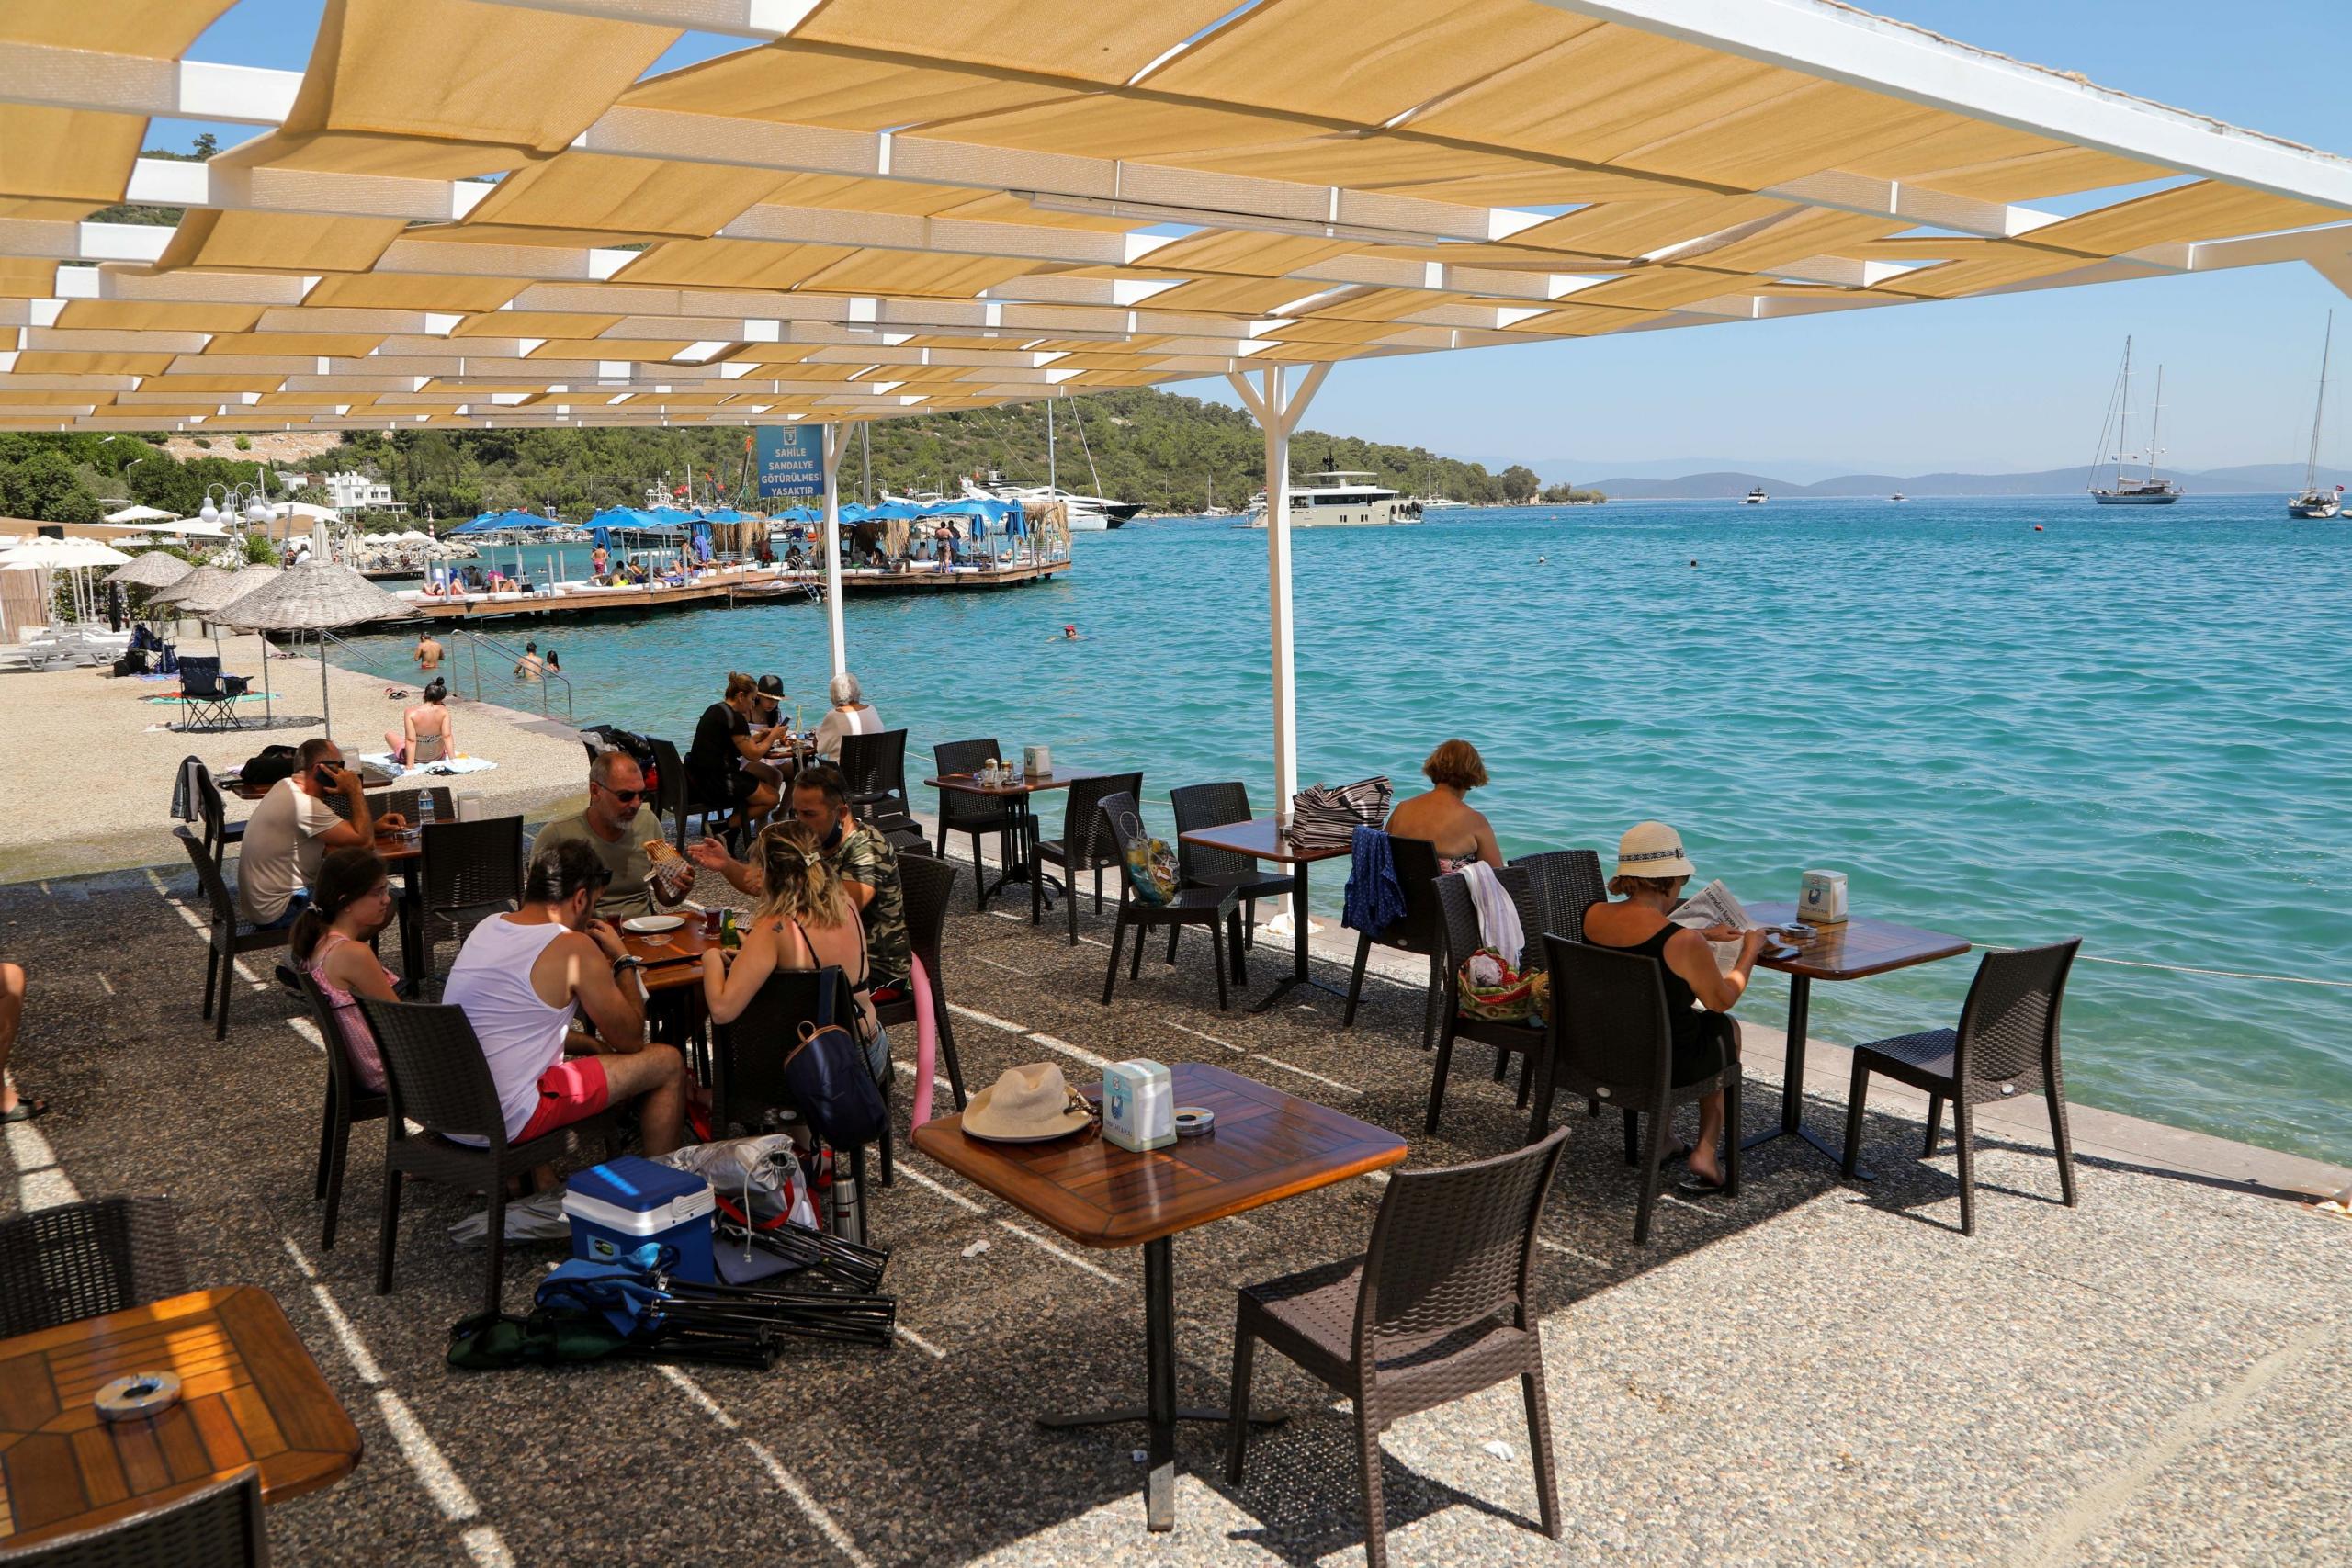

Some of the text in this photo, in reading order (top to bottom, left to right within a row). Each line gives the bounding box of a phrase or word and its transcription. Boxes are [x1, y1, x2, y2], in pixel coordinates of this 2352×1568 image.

[775, 447, 807, 457] SAHİLE
[768, 460, 814, 470] SANDALYE
[761, 471, 822, 484] GÖTÜRÜLMESİ
[772, 486, 814, 496] YASAKTIR
